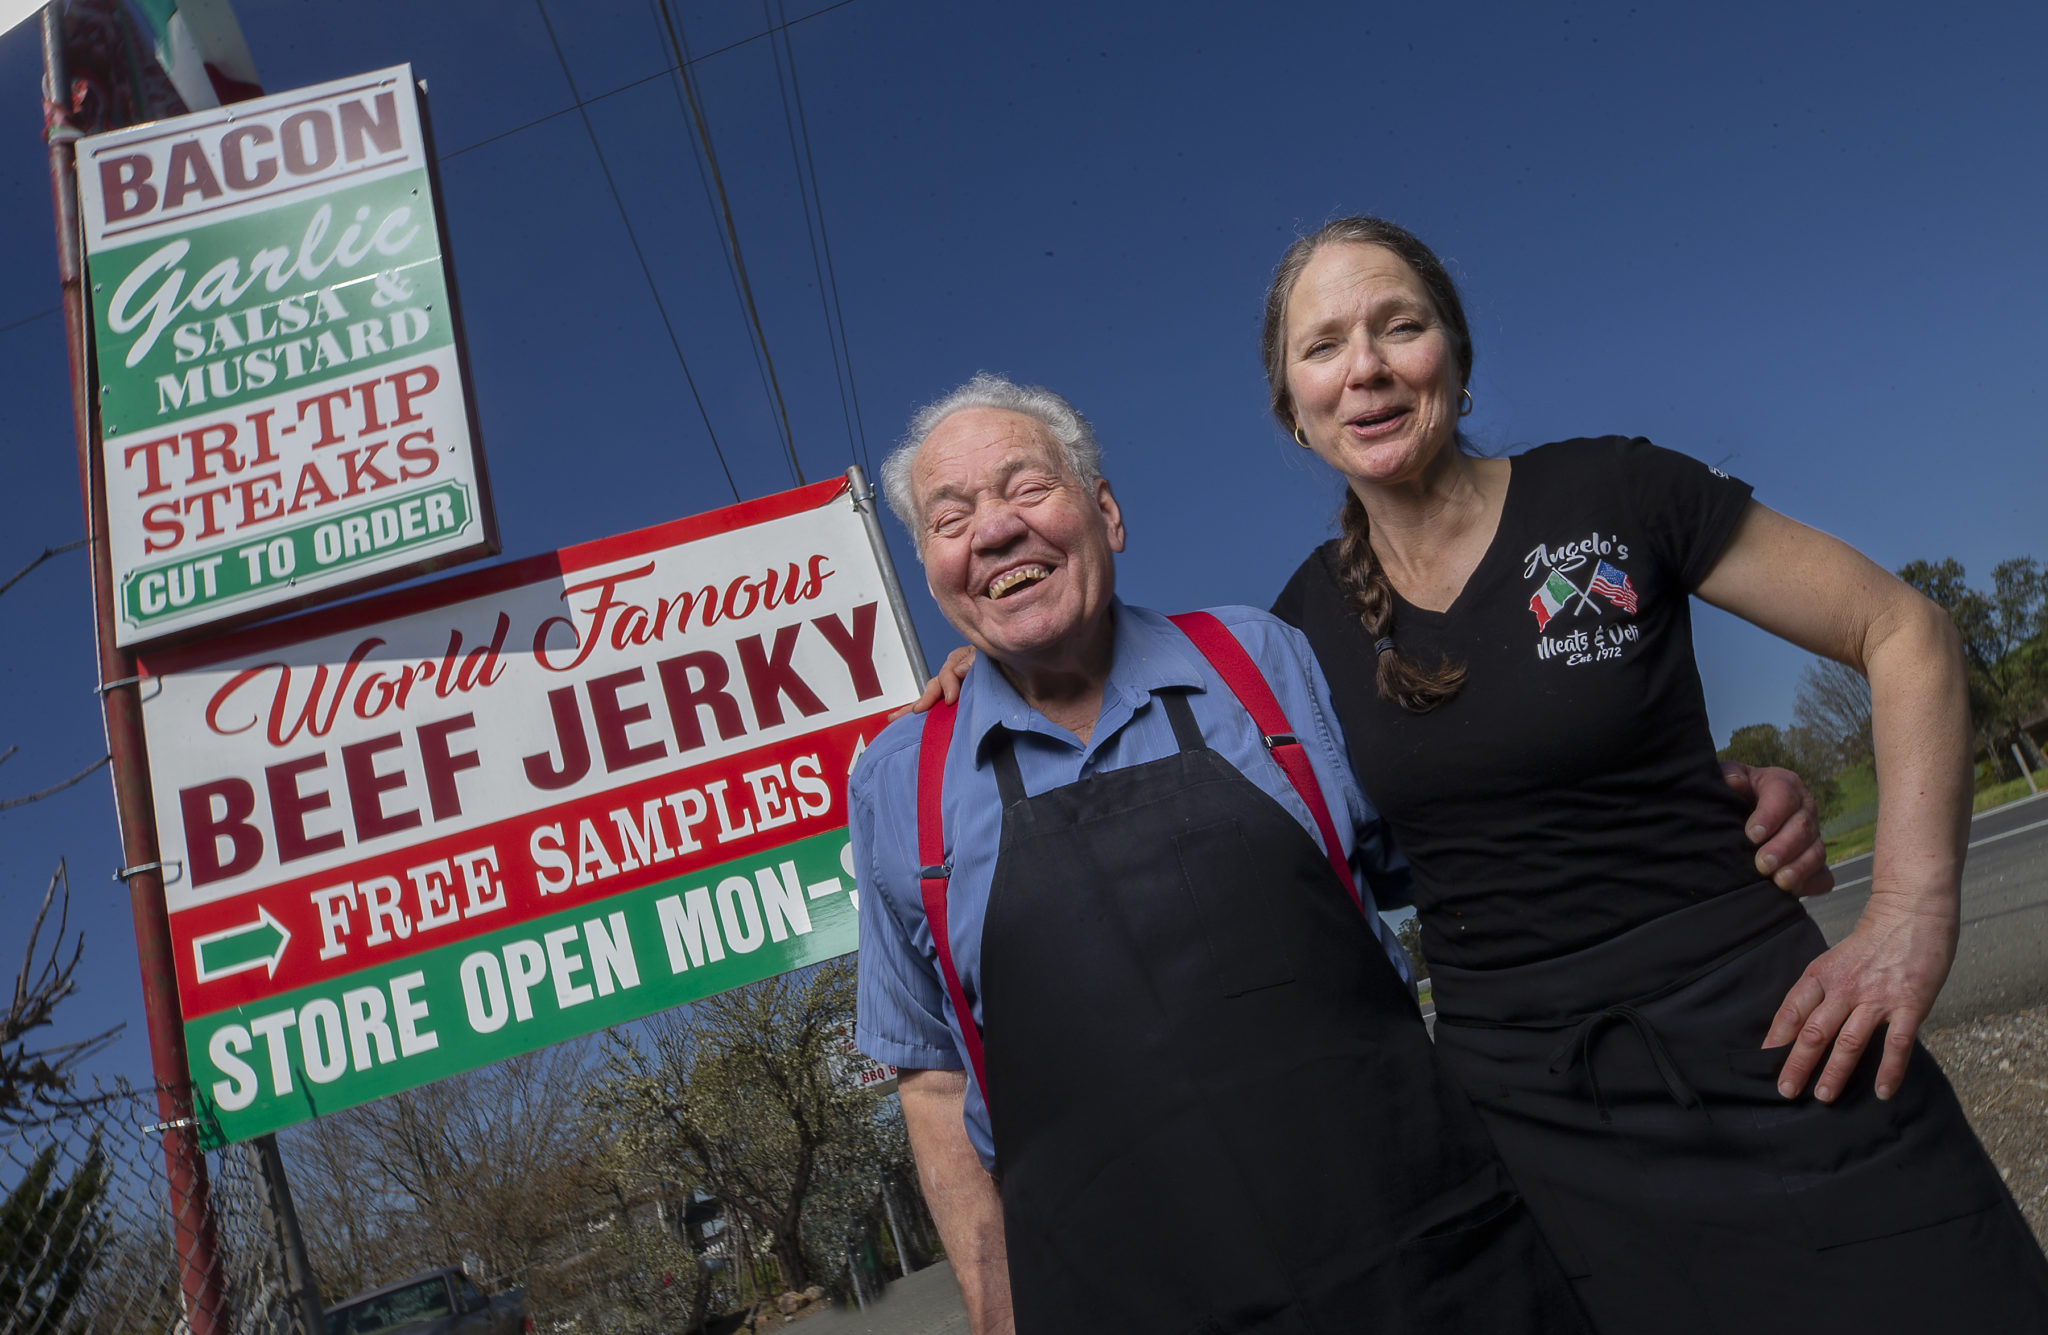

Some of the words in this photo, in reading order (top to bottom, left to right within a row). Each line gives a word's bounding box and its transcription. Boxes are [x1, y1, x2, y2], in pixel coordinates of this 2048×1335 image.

[99, 92, 402, 226] BACON
[108, 203, 420, 368] Garlic
[173, 288, 349, 364] SALSA
[371, 270, 414, 309] &
[155, 307, 431, 415] MUSTARD
[124, 365, 440, 500] TRI-TIP
[142, 429, 440, 555] STEAKS
[138, 556, 223, 616] CUT
[240, 538, 296, 586] TO
[314, 491, 454, 566] ORDER
[1523, 532, 1629, 579] Angelo's
[206, 611, 506, 747] World
[533, 555, 835, 671] Famous
[1537, 630, 1589, 660] Meats
[1594, 625, 1605, 650] &
[1607, 622, 1639, 645] Deli
[1566, 653, 1593, 666] Est
[1596, 647, 1622, 661] 1972
[179, 712, 481, 888] BEEF
[522, 602, 886, 791] JERKY
[310, 846, 507, 961] FREE
[528, 754, 832, 895] SAMPLES
[208, 971, 438, 1112] STORE
[460, 911, 640, 1034] OPEN
[861, 1067, 886, 1083] BBQ
[888, 1064, 898, 1076] B
